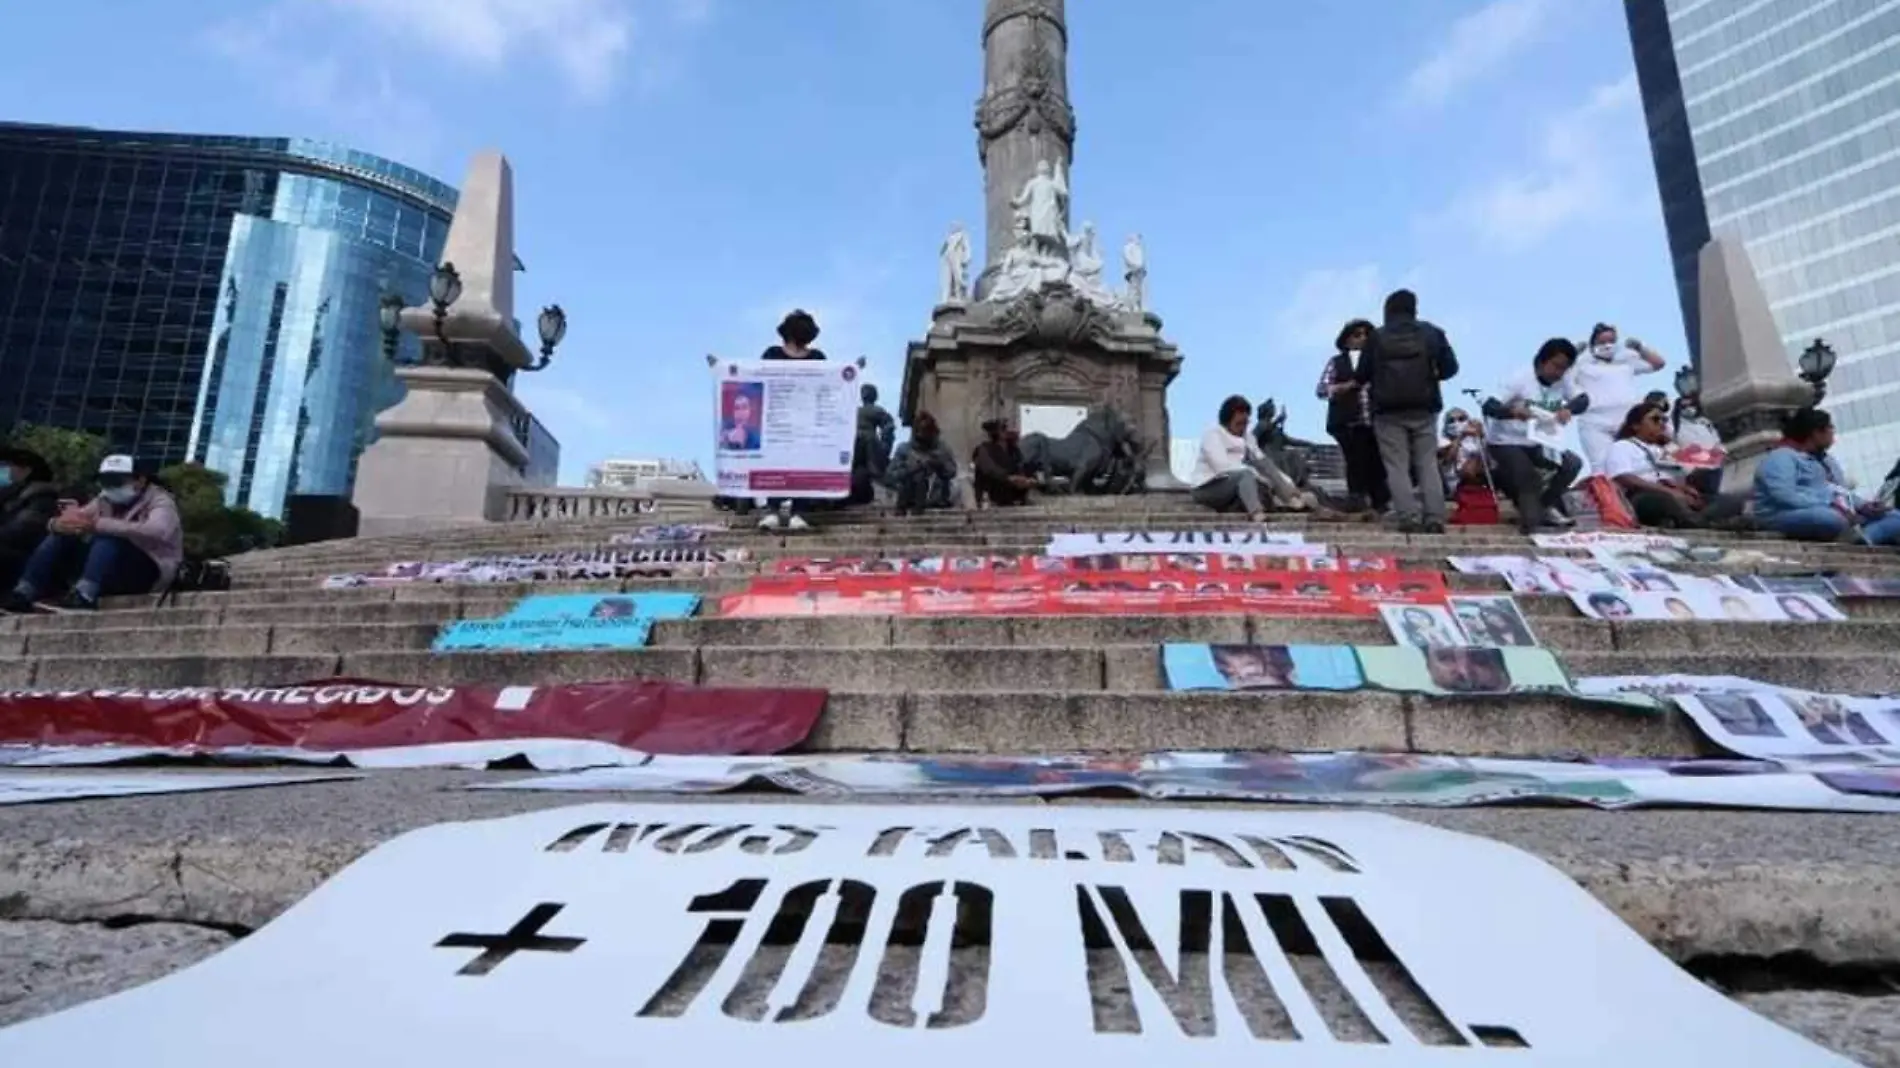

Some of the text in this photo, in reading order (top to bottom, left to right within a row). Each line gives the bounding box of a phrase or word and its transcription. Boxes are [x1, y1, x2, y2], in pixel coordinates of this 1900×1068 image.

[432, 877, 1532, 1048] + 100 MIL
